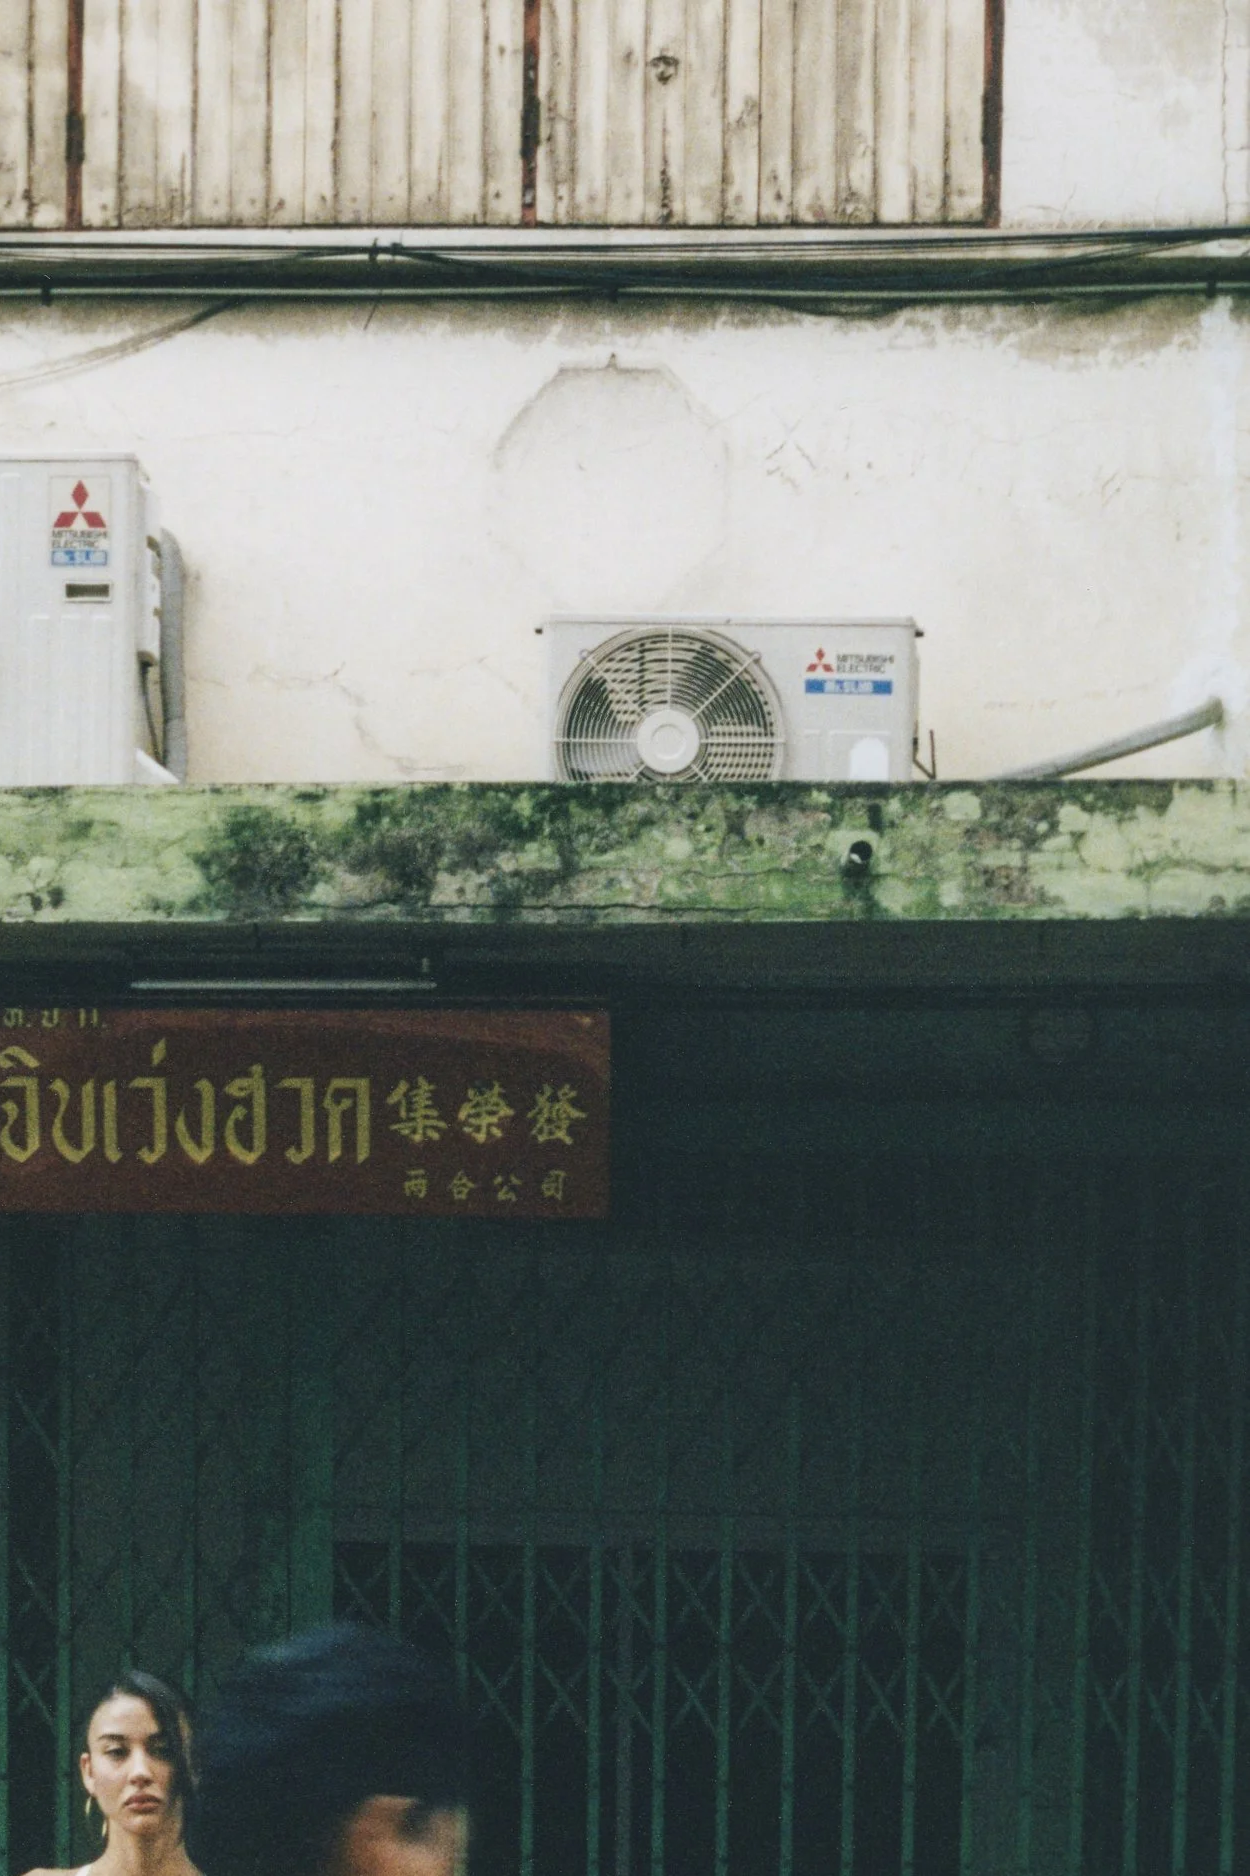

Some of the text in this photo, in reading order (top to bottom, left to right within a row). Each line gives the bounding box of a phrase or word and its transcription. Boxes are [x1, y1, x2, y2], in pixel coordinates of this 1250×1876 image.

[52, 529, 108, 539] MITSUBISHI
[836, 654, 894, 664] MITSUBISHI
[836, 664, 885, 673] ELECTRIC
